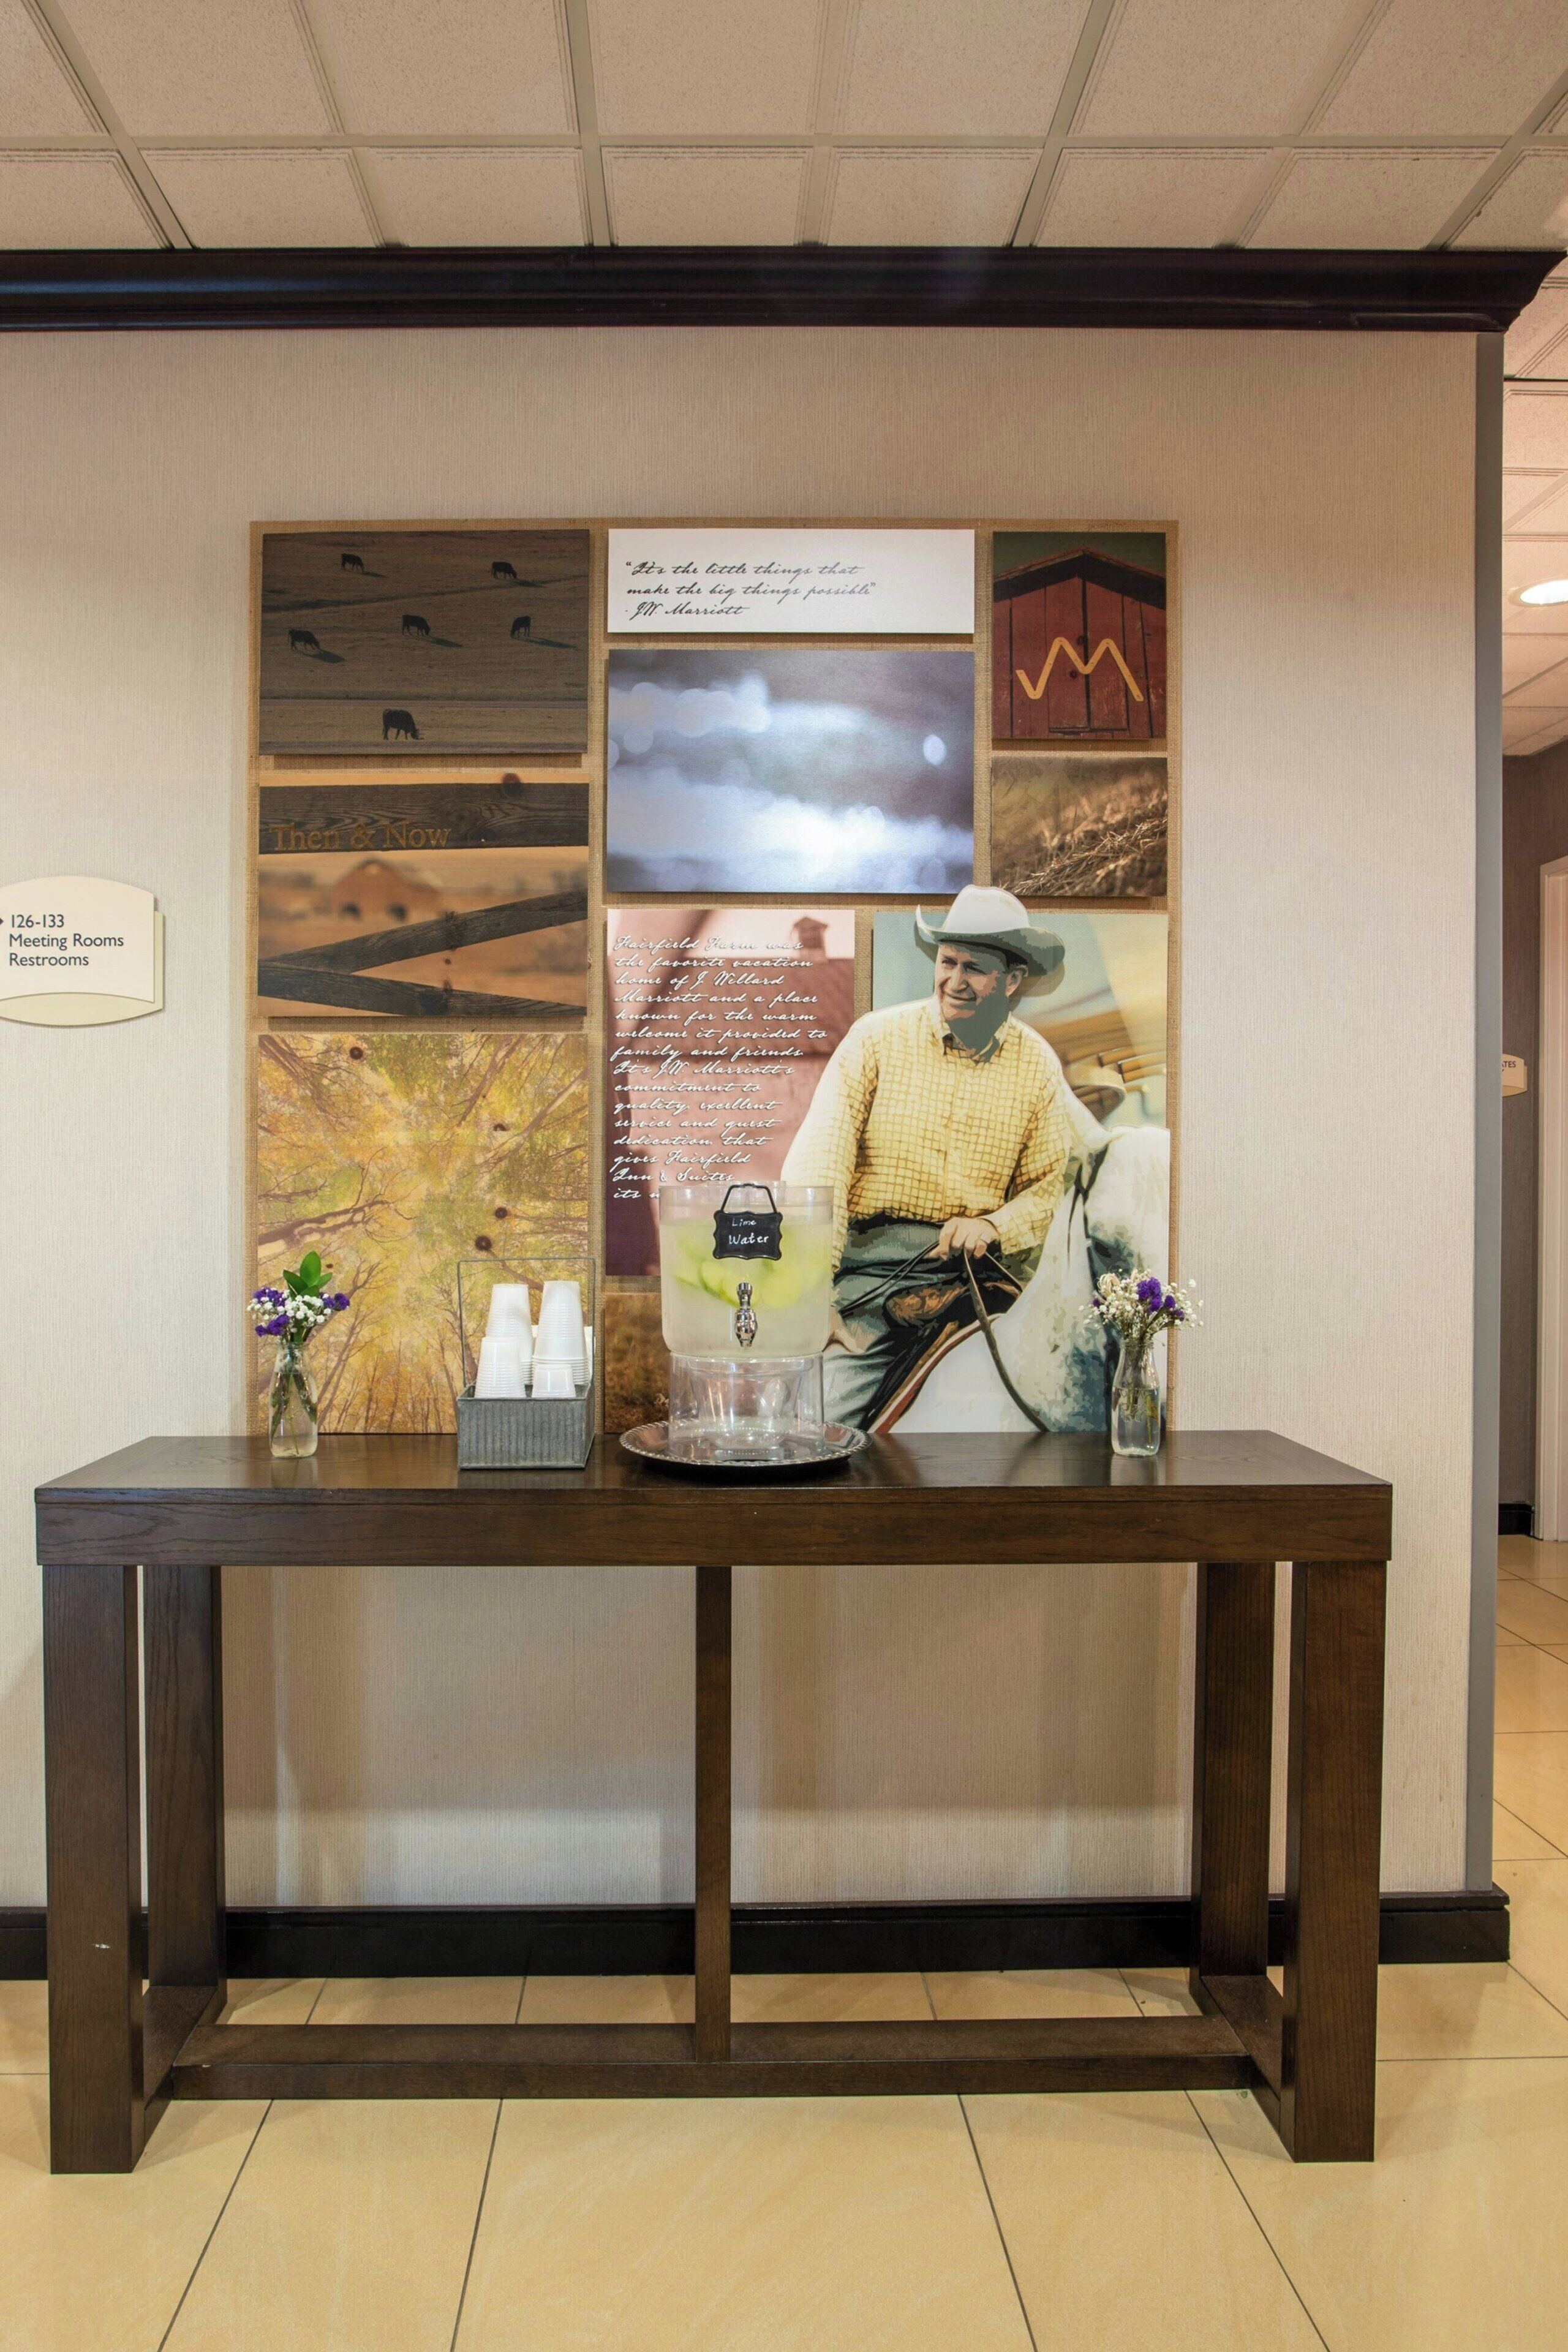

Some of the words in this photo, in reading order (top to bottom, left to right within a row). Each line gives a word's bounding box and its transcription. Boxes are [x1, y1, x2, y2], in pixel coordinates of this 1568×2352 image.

[672, 562, 698, 574] the
[706, 562, 748, 575] little
[753, 562, 812, 584] things
[818, 562, 865, 575] that
[627, 584, 669, 595] make
[676, 582, 703, 595] the
[709, 584, 736, 605] big
[742, 582, 801, 605] things
[803, 582, 876, 601] possible”
[665, 601, 750, 615] Marriott
[270, 822, 342, 851] Then
[350, 822, 376, 848] &
[380, 820, 451, 848] Now
[11, 914, 64, 928] 126-133
[9, 933, 67, 951] Meeting
[73, 933, 124, 947] Rooms
[613, 935, 699, 954] Fairfield
[705, 935, 756, 951] Farm
[766, 941, 804, 950] was
[9, 952, 89, 966] Restrooms
[614, 954, 644, 967] the
[647, 956, 725, 973] favorite
[733, 956, 813, 967] vacation
[616, 971, 662, 984] home
[670, 975, 688, 990] of
[714, 971, 784, 986] Willard
[614, 989, 708, 1002] Marriott
[709, 993, 747, 1002] and
[768, 991, 818, 1009] place
[616, 1009, 680, 1020] known
[684, 1011, 717, 1026] for
[724, 1008, 753, 1020] the
[616, 1026, 687, 1038] welcome
[696, 1027, 722, 1038] it
[717, 1028, 801, 1044] provided
[807, 1030, 827, 1038] to
[609, 1044, 682, 1061] family
[690, 1047, 728, 1055] and
[613, 1059, 652, 1075] It's
[693, 1060, 795, 1074] Marriott's
[614, 1081, 741, 1091] commitment
[742, 1083, 761, 1091] to
[699, 1098, 783, 1111] excellent
[614, 1117, 672, 1128] service
[679, 1118, 717, 1127] and
[720, 1118, 782, 1137] guest
[722, 1133, 774, 1145] that
[609, 1152, 659, 1173] gives
[665, 1150, 751, 1169] Fairfield
[612, 1167, 654, 1182] Inn
[660, 1169, 667, 1182] &
[676, 1167, 734, 1181] Suites
[613, 1188, 641, 1198] its
[732, 1218, 756, 1227] Lime
[729, 1232, 769, 1245] Water
